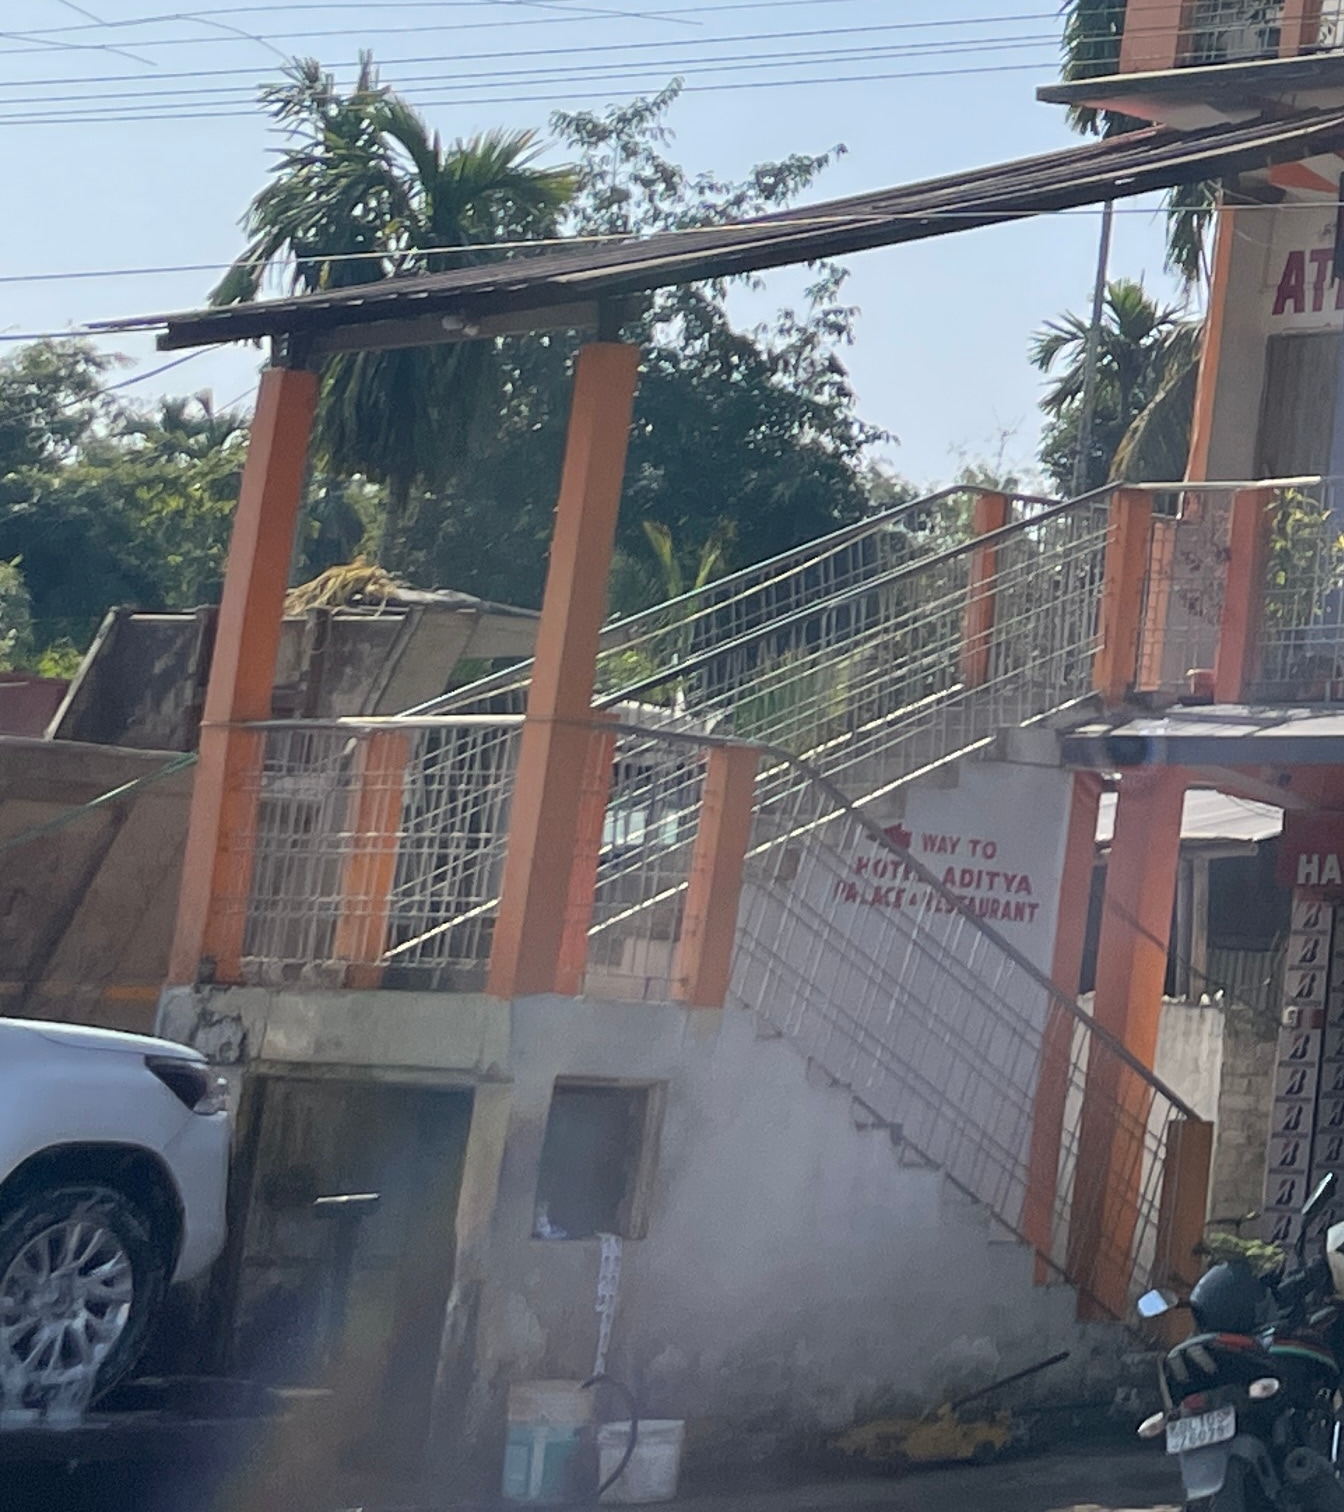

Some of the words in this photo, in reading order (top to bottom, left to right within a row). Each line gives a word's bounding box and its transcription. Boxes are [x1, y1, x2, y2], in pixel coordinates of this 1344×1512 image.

[921, 832, 961, 857] WAY
[968, 839, 998, 861] TO
[833, 881, 906, 909] PALACE
[941, 866, 1033, 896] ADITYA
